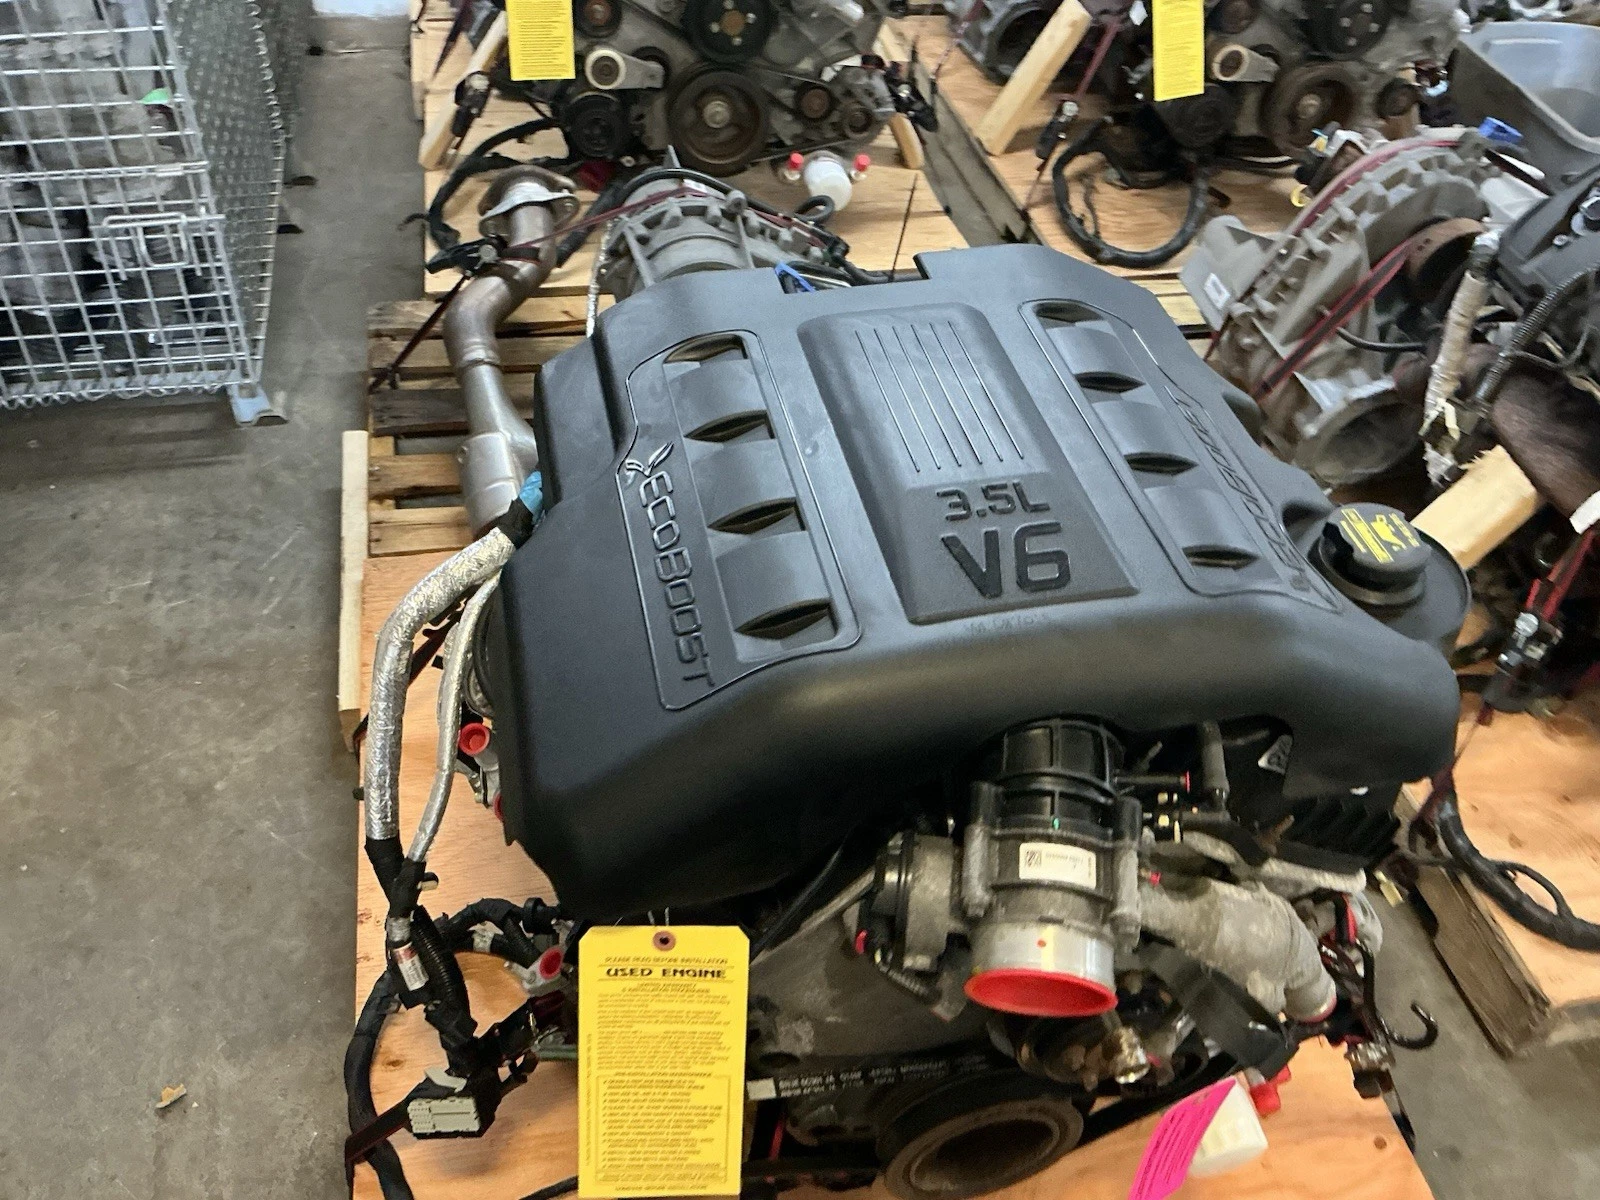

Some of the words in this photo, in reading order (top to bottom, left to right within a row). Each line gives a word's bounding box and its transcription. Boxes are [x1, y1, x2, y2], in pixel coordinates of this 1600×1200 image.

[936, 479, 1051, 522] 3.5L
[639, 470, 715, 687] ECOBOOST
[940, 521, 1071, 599] V6
[606, 967, 653, 977] USED
[661, 968, 727, 979] ENGINE
